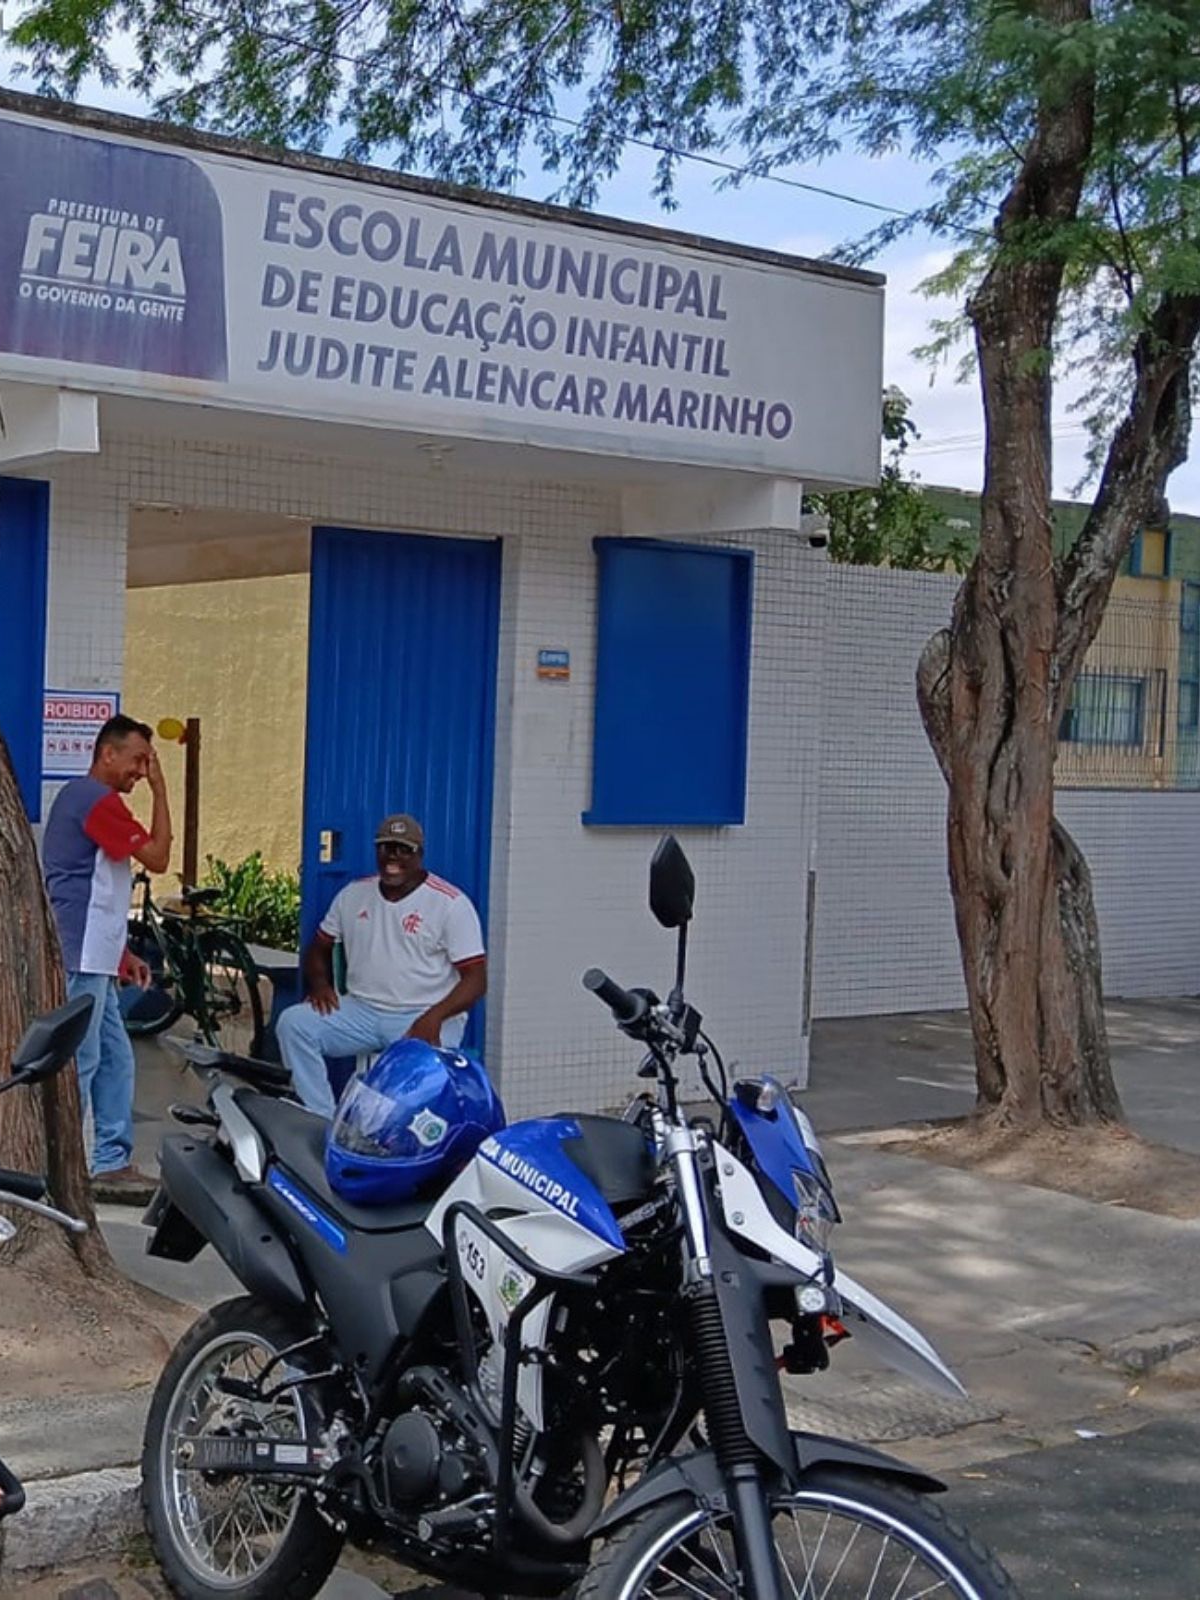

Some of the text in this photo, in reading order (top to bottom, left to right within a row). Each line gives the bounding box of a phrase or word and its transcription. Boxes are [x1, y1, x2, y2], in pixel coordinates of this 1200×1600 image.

[48, 198, 165, 233] PREFEITURA DE
[22, 213, 187, 296] FEIRA
[263, 189, 727, 320] ESCOLA MUNICIPAL
[19, 282, 186, 322] O GOVERNO DA GENTE
[261, 263, 730, 377] DE EDUCAÇÃO INFANTIL
[257, 330, 793, 440] JUDITE ALENCAR MARINHO
[44, 701, 111, 719] ROIBIDO
[498, 1149, 580, 1218] MUNICIPAL
[466, 1242, 485, 1280] 153
